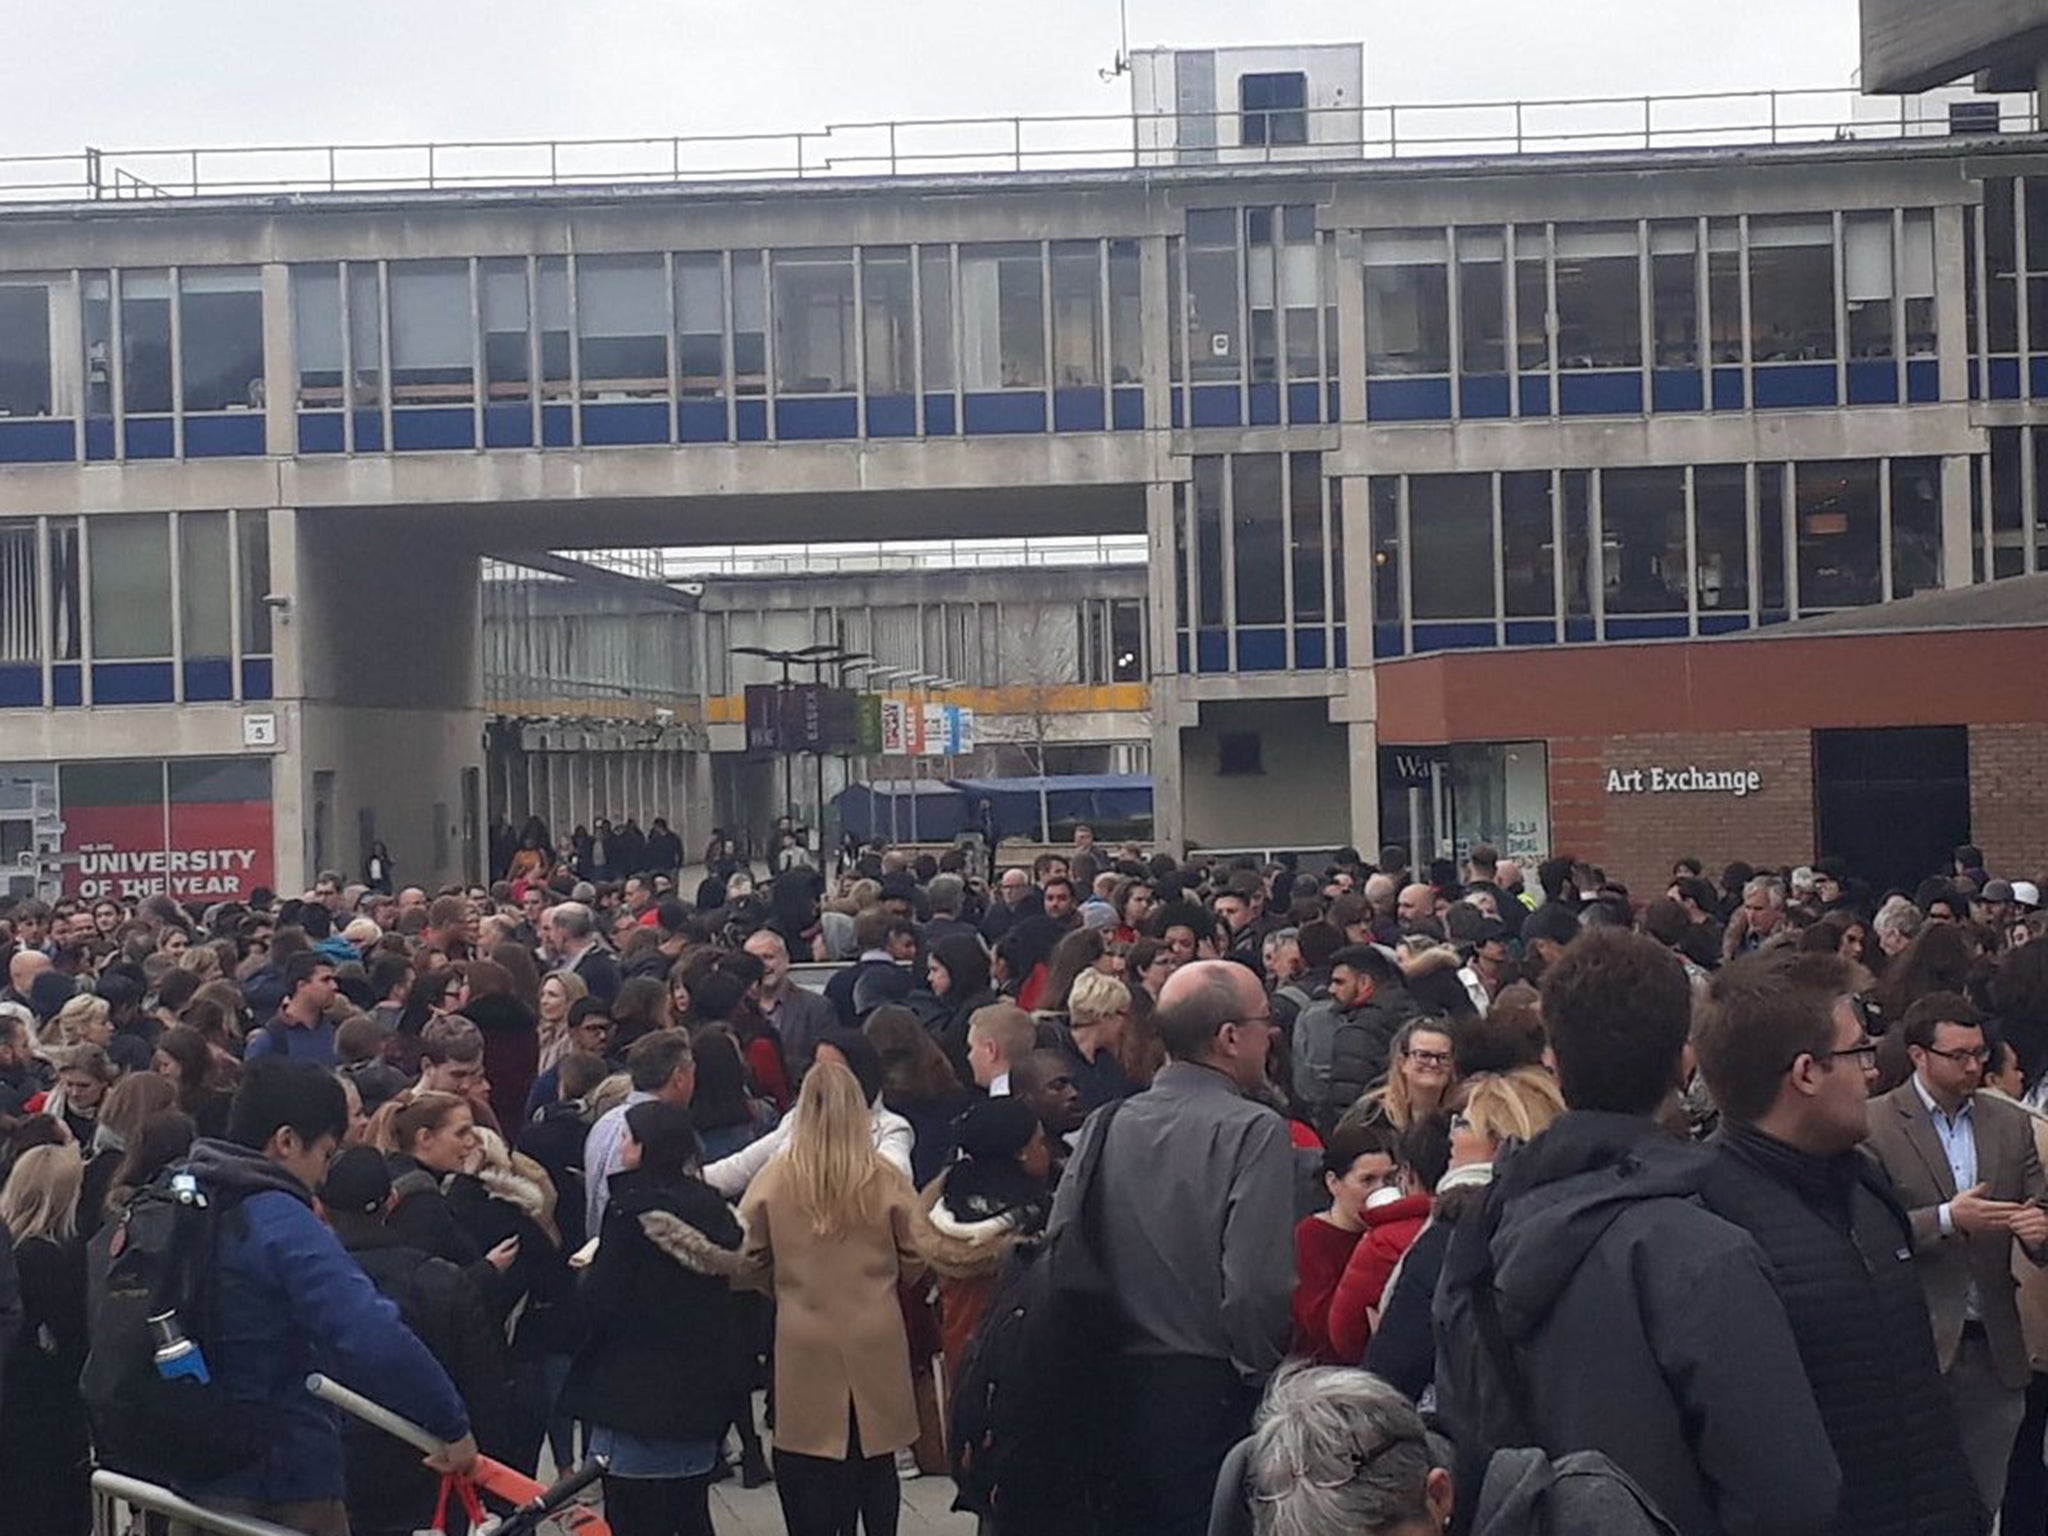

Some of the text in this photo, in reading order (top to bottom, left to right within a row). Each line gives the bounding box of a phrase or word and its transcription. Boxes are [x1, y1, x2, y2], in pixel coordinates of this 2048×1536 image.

[1606, 765, 1760, 796] Art Exchange
[79, 849, 256, 875] UNIVERSITY
[79, 876, 240, 899] OF THE YEAR
